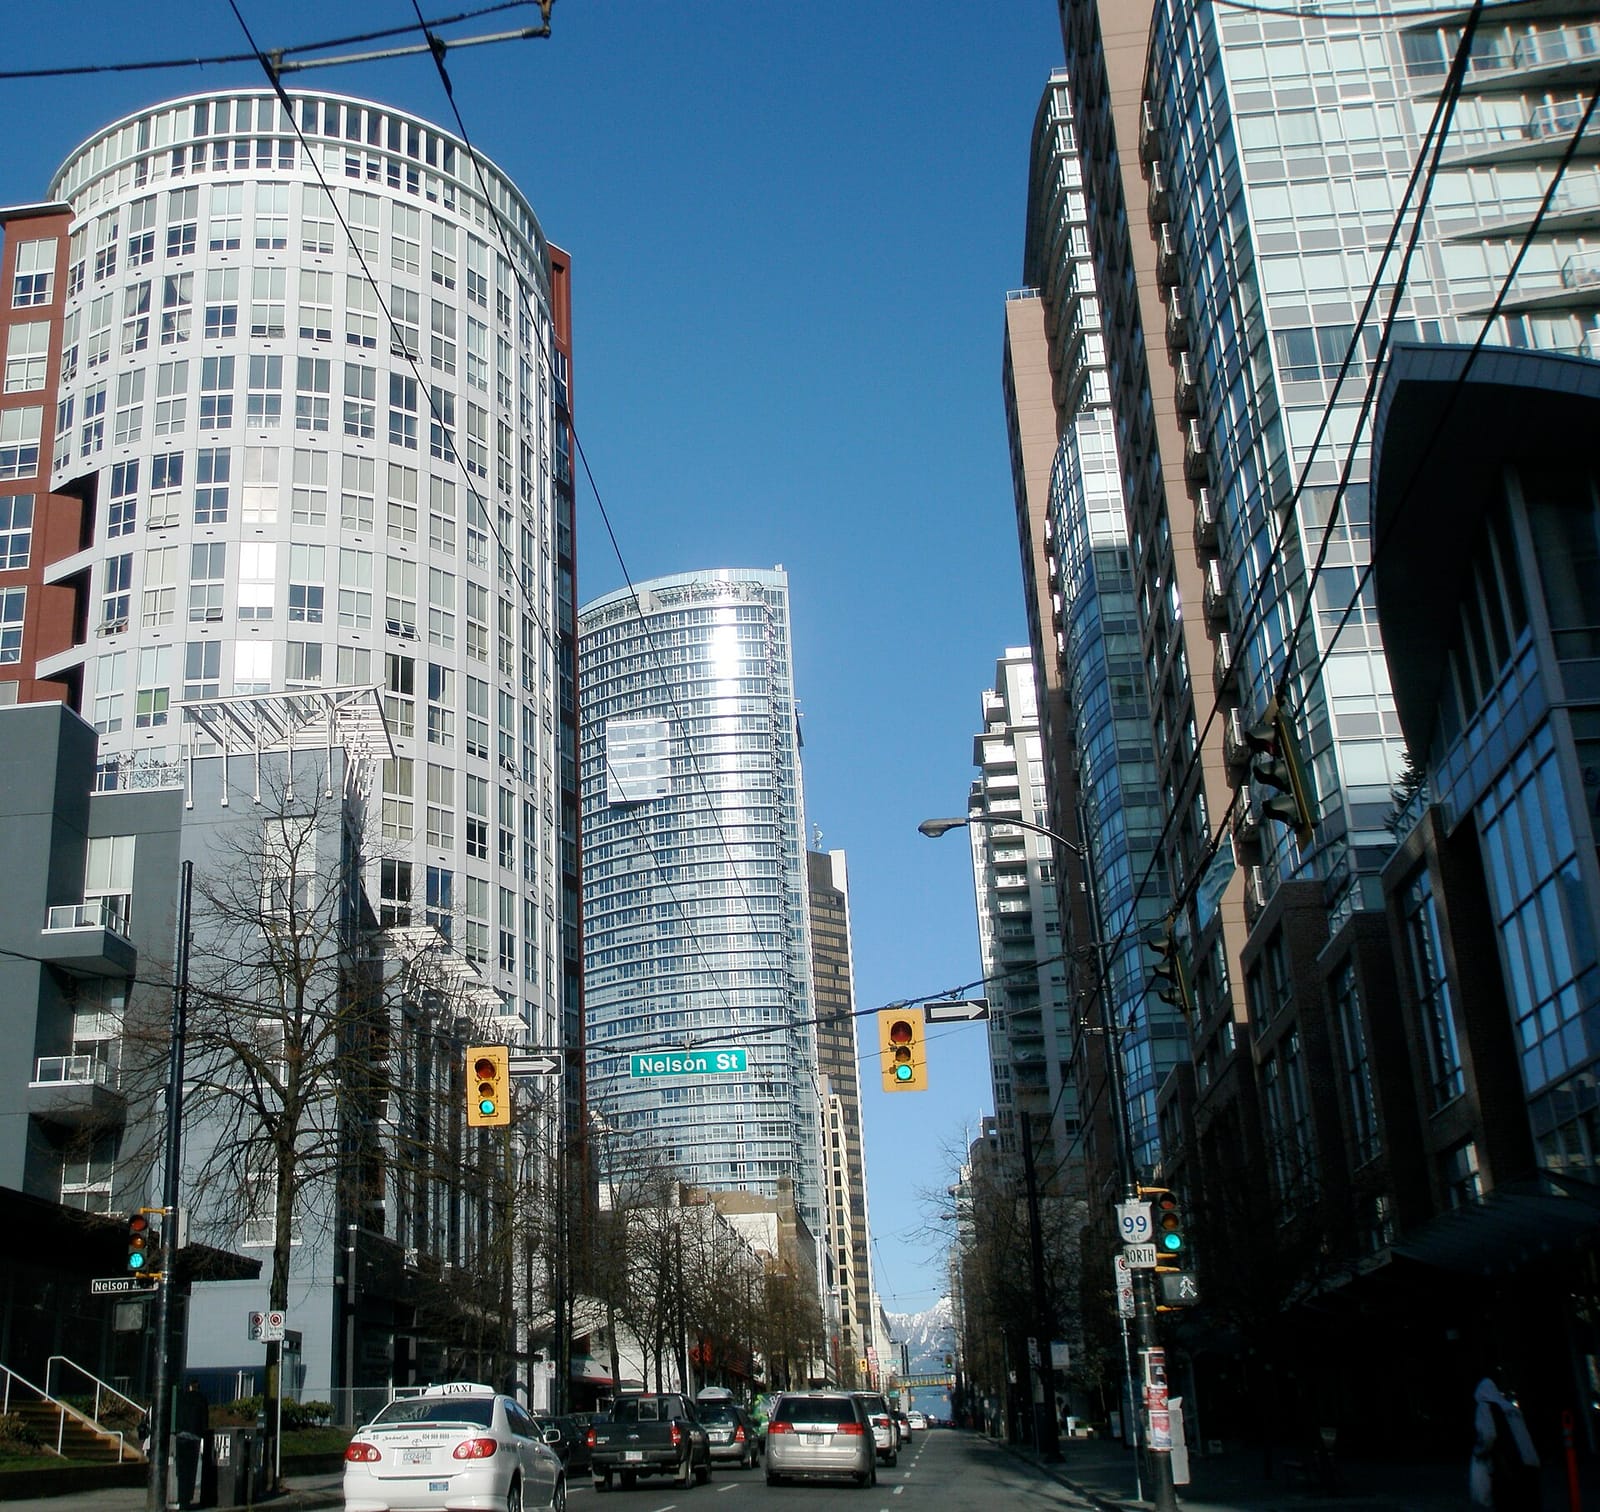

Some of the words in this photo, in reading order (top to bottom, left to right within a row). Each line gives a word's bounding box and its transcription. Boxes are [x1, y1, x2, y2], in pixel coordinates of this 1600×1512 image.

[639, 1056, 707, 1074] Nelson
[716, 1053, 739, 1070] St
[1123, 1215, 1147, 1234] 99
[1124, 1248, 1155, 1263] NORTH
[94, 1280, 129, 1291] Nelson
[446, 1384, 473, 1394] TAXI
